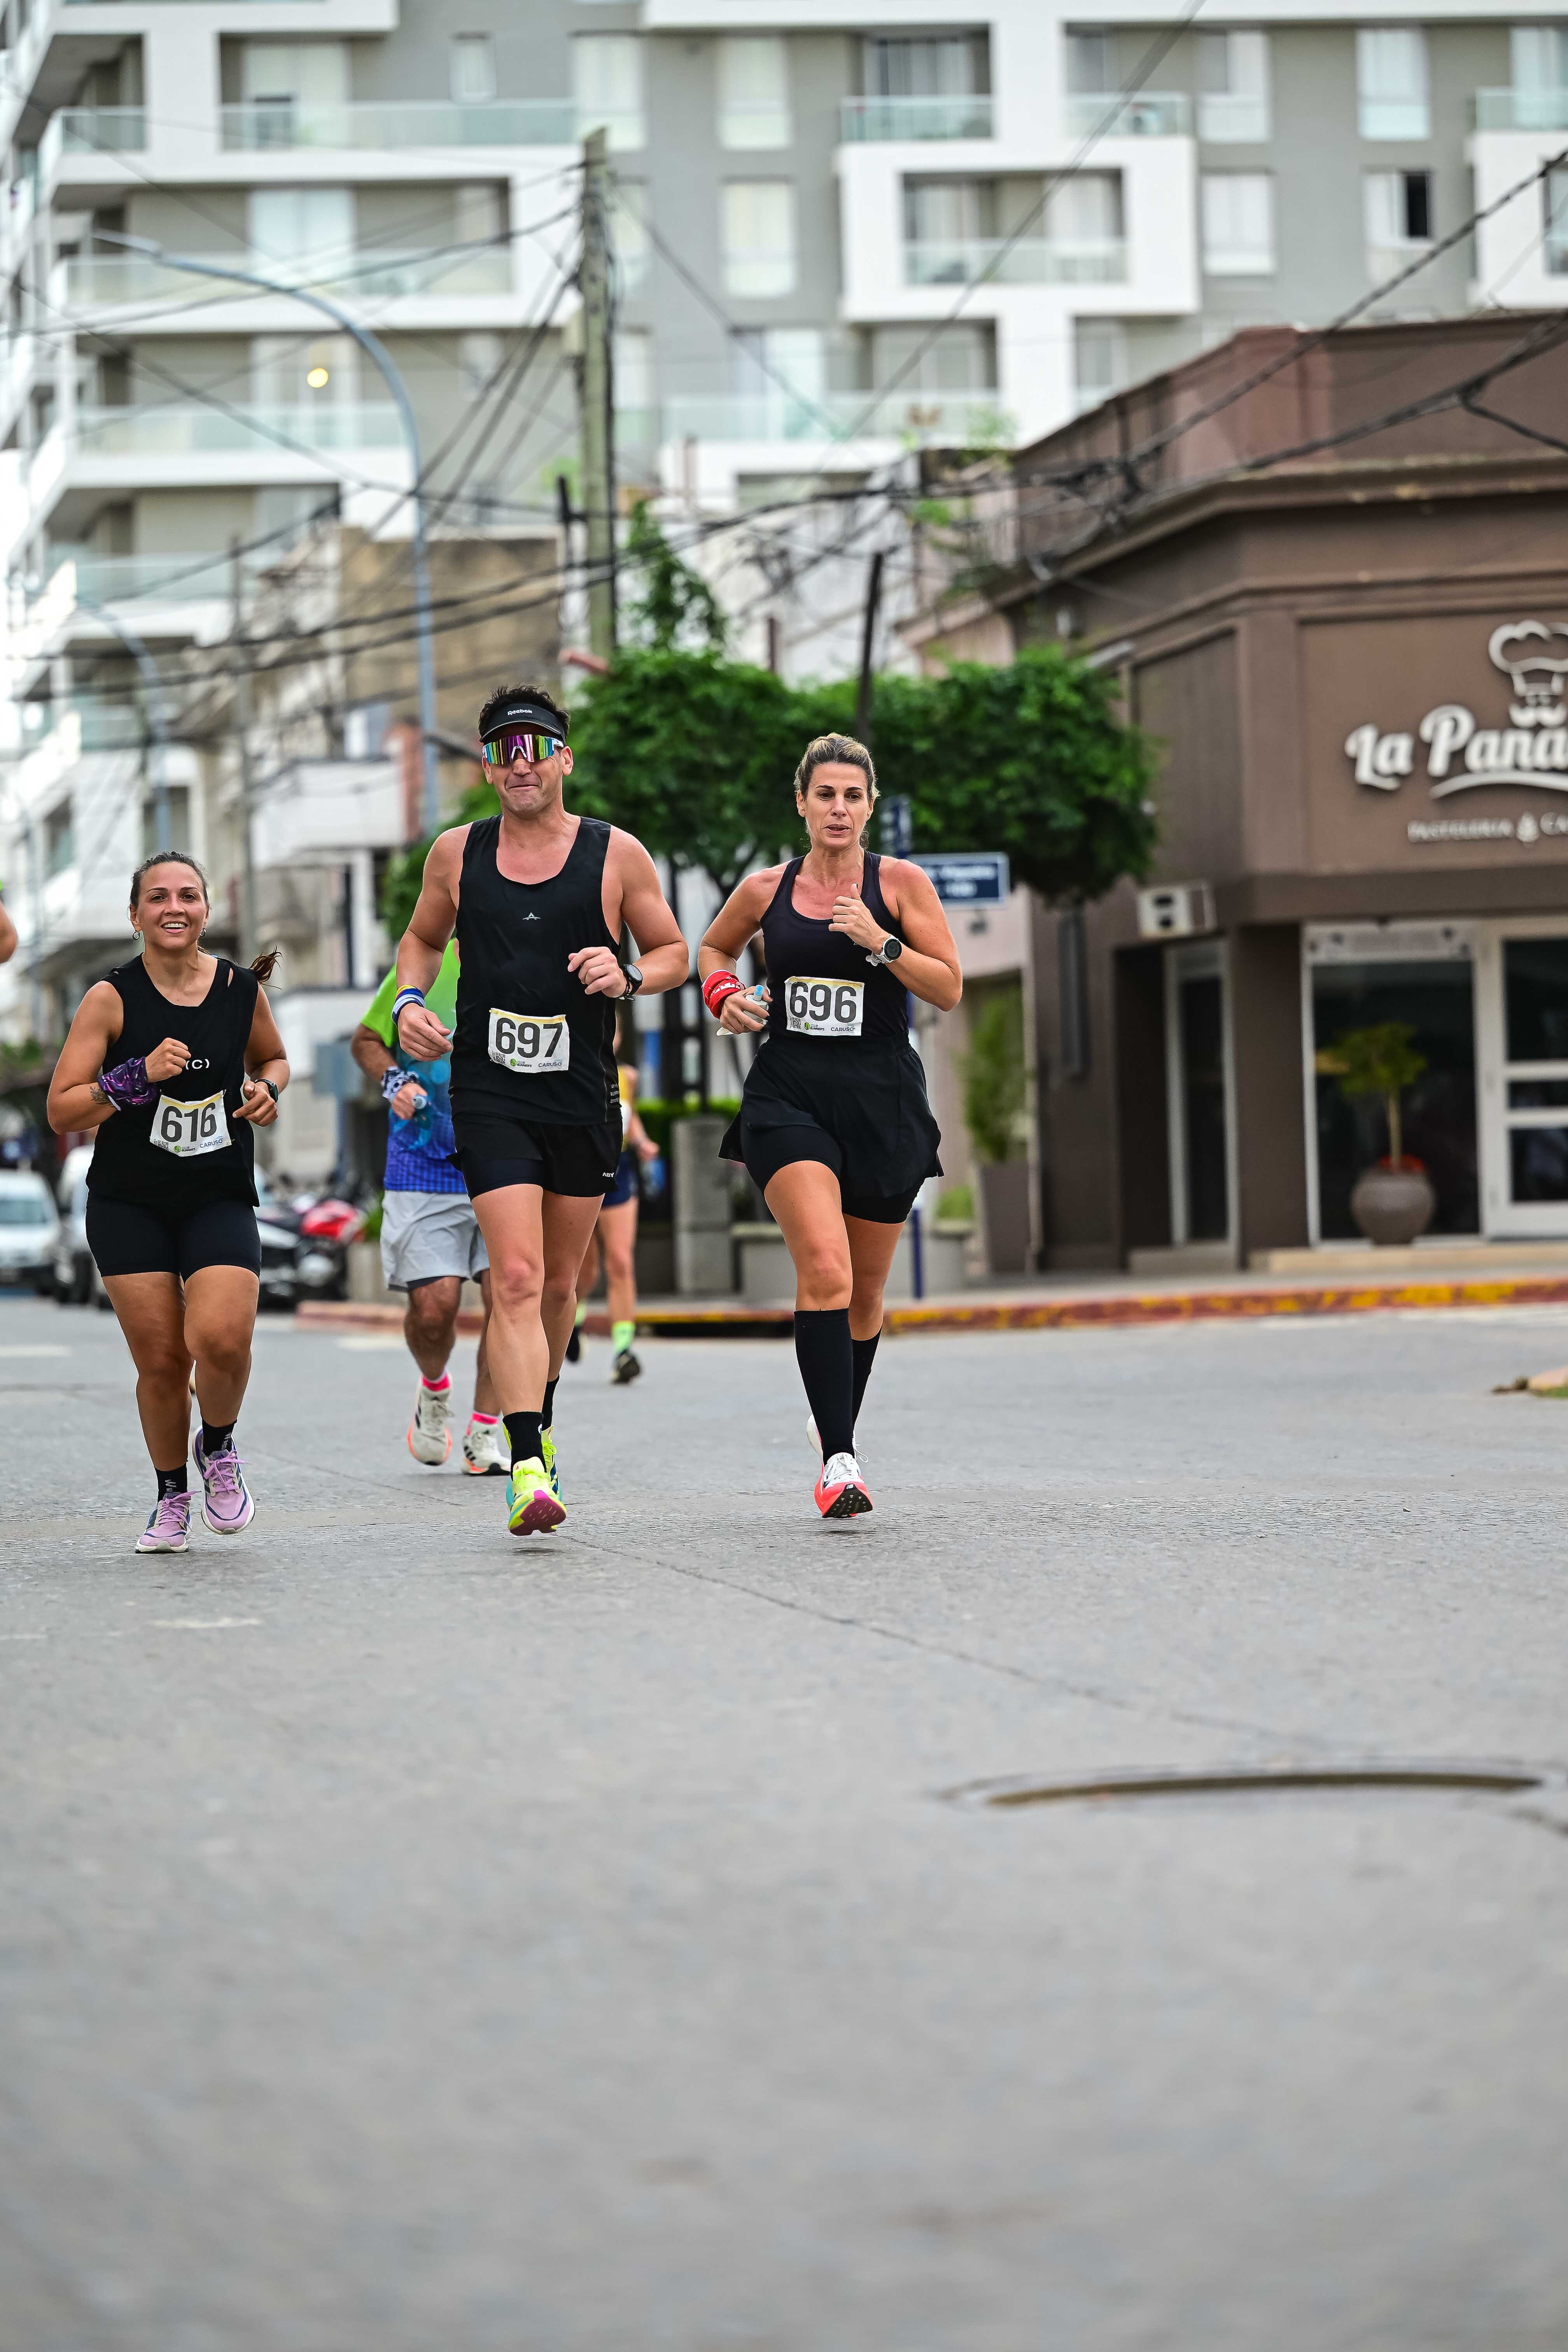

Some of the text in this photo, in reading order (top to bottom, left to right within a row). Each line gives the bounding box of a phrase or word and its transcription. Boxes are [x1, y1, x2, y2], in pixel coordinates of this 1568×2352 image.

[1345, 723, 1414, 790] La
[789, 981, 857, 1023] 696
[495, 1017, 563, 1059] 697
[161, 1102, 217, 1143] 616
[200, 1139, 223, 1148] CARUSO
